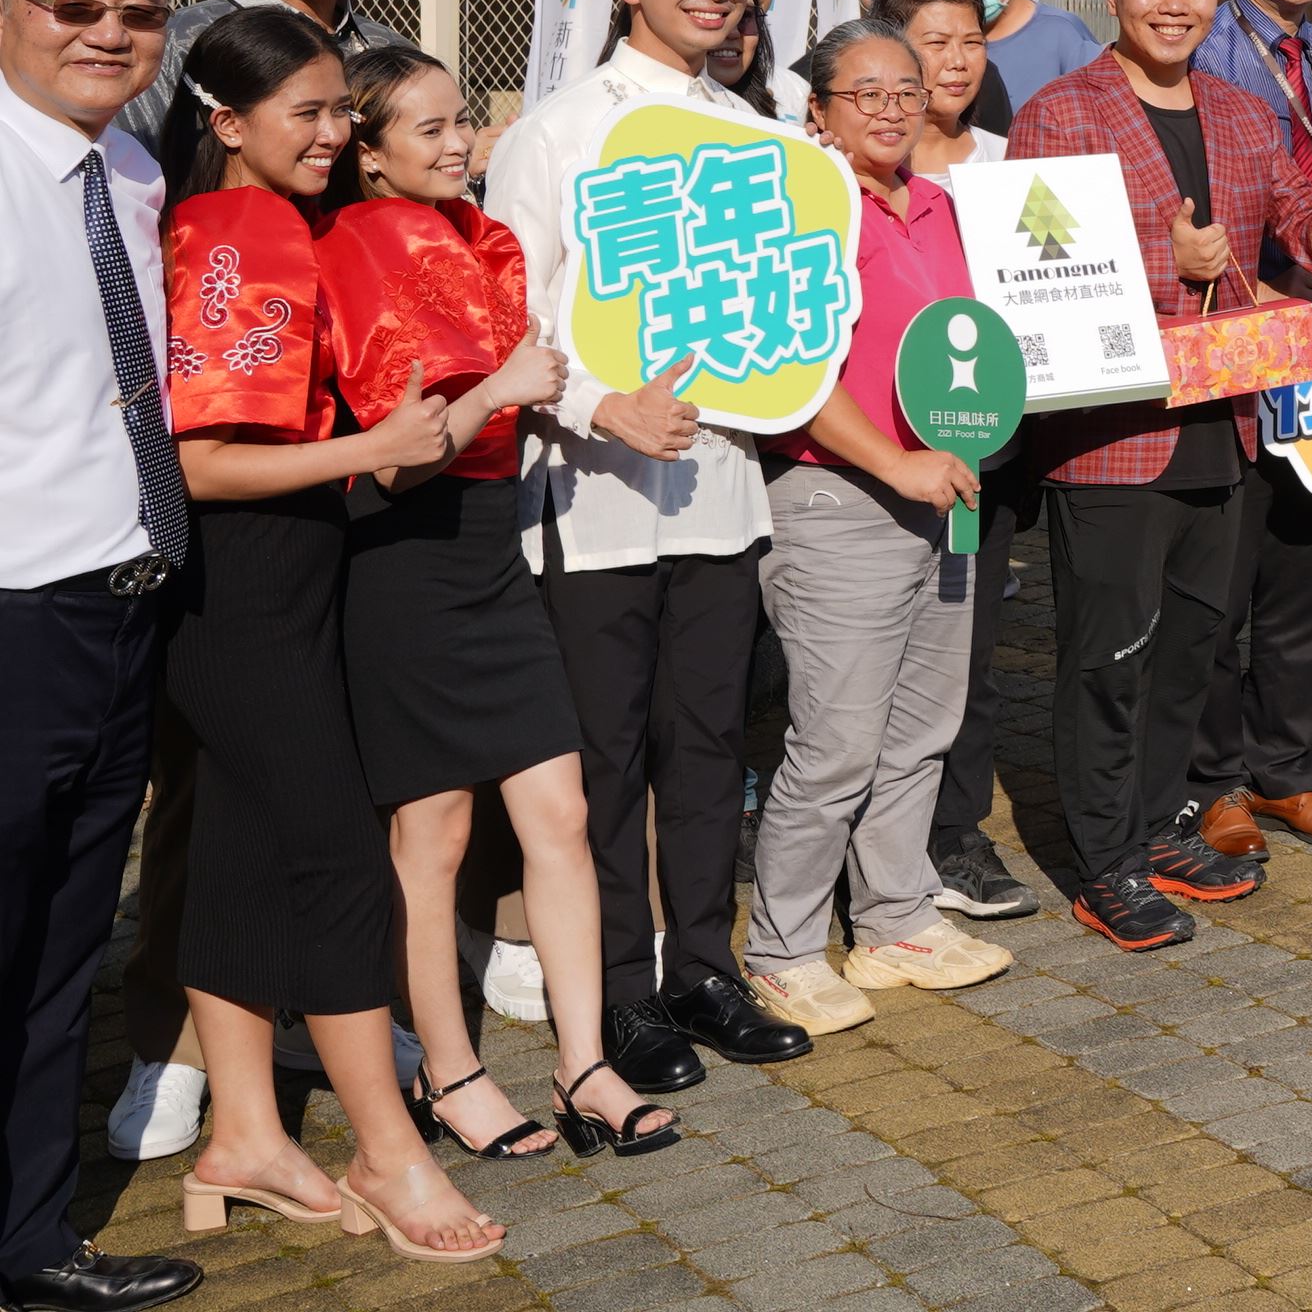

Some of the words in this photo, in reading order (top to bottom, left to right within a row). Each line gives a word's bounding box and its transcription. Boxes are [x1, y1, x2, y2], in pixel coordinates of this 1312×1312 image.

[581, 146, 790, 295] 青年
[997, 258, 1120, 284] Danongnet
[1002, 281, 1124, 307] 大農網食材直供站
[645, 238, 843, 380] 共好
[1121, 363, 1141, 374] book
[929, 410, 999, 427] 日日風味所
[955, 430, 975, 438] Food
[978, 431, 991, 439] Bar
